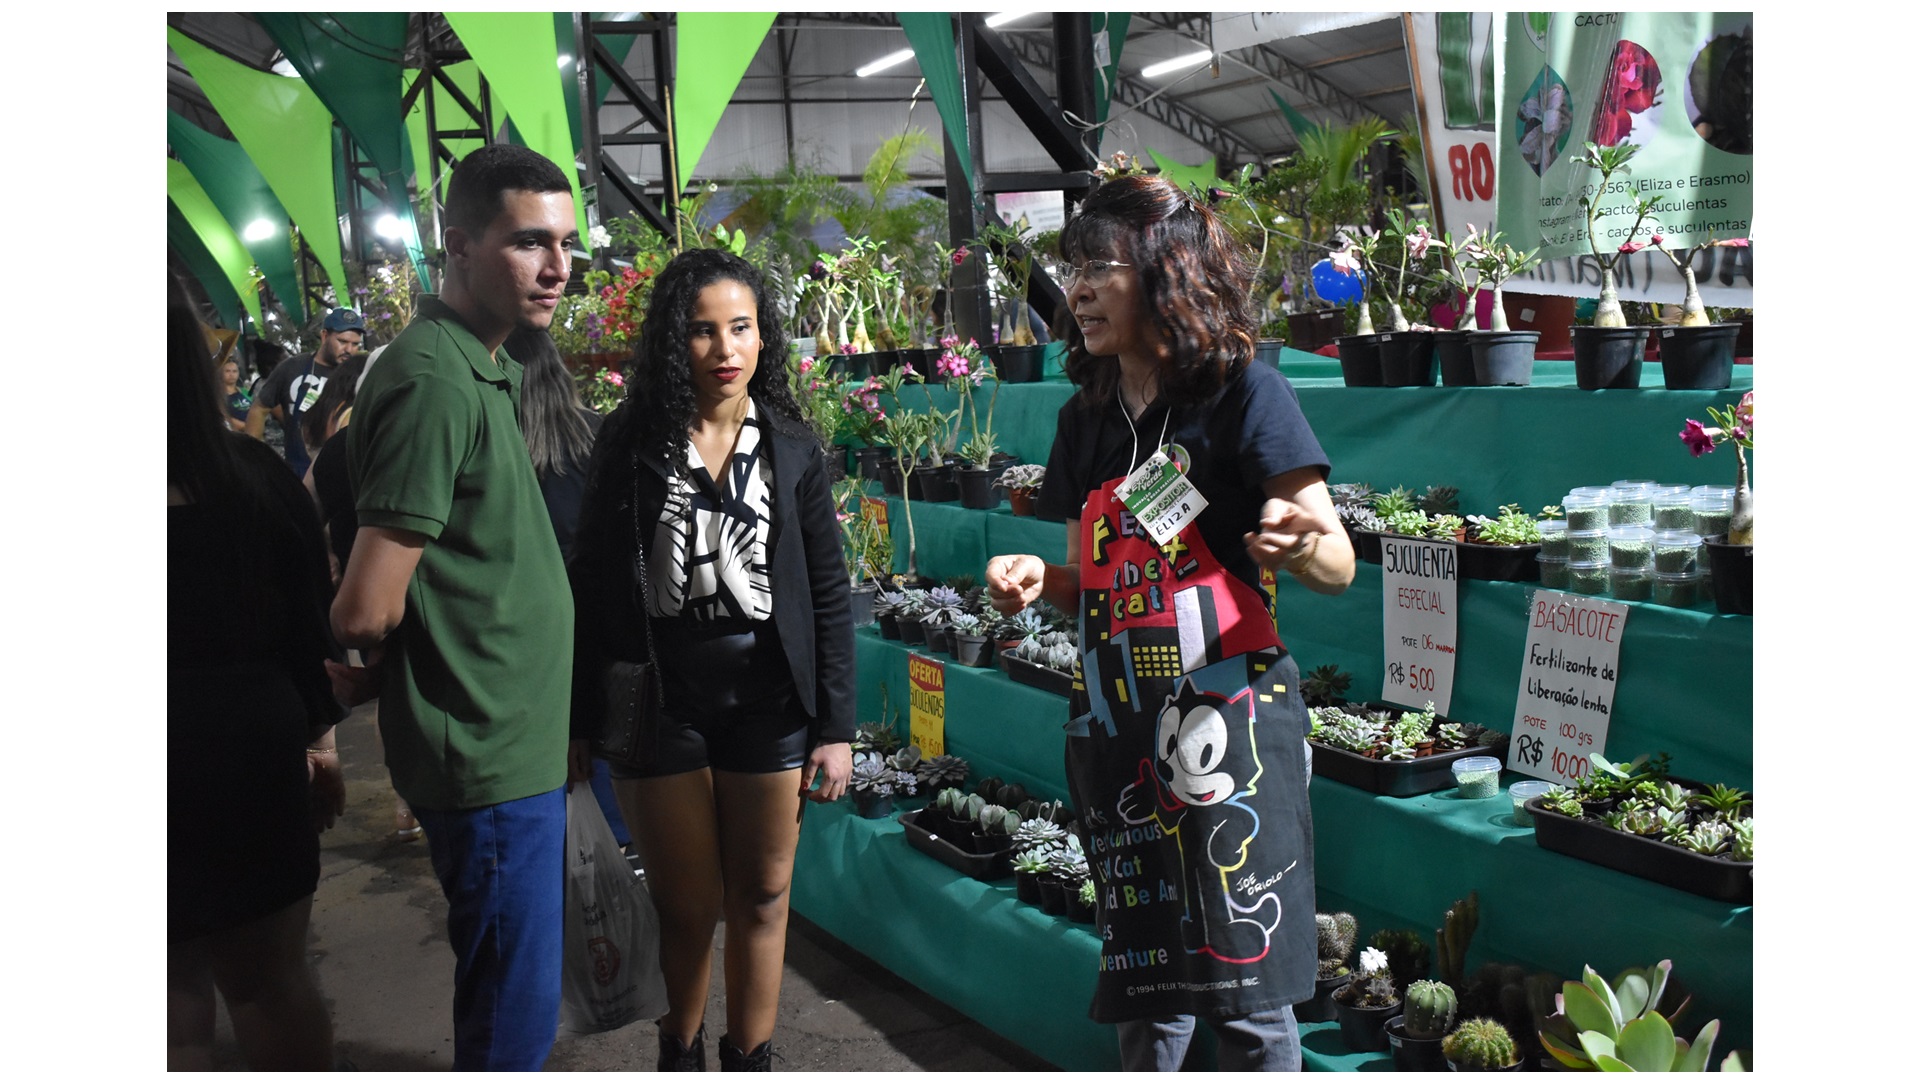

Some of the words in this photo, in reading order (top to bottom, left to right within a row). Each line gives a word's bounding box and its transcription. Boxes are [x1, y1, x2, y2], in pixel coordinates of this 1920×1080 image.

[1636, 178, 1672, 194] (Eliza
[1676, 179, 1686, 190] e
[1690, 170, 1751, 189] Erasmo)
[1655, 225, 1664, 236] e
[1668, 218, 1748, 235] suculentas
[1141, 481, 1189, 524] EXPOSITOR
[1386, 543, 1456, 581] SUCULENTA
[1113, 586, 1163, 620] cat
[1398, 587, 1446, 615] ESPECIAL
[1533, 600, 1619, 643] BASACOTE
[1401, 635, 1418, 649] POTE
[1421, 634, 1434, 650] 06
[910, 659, 943, 688] OFERTA
[1530, 643, 1599, 678] Fertilizante
[1601, 662, 1615, 682] de
[1388, 661, 1405, 685] R$
[1409, 664, 1435, 693] 5,00
[910, 687, 944, 719] SUCULENTAS
[1580, 689, 1608, 715] lenta
[1523, 715, 1547, 730] POTE
[1559, 722, 1577, 739] 100
[1578, 732, 1593, 746] grs
[1517, 733, 1544, 768] R$
[1551, 746, 1588, 780] 10,00
[1114, 855, 1142, 878] Cat
[1123, 884, 1151, 908] Be
[1236, 872, 1257, 892] JOE
[1247, 871, 1283, 896] ORIOLO
[1100, 947, 1168, 972] venture
[1157, 982, 1177, 991] FELIX
